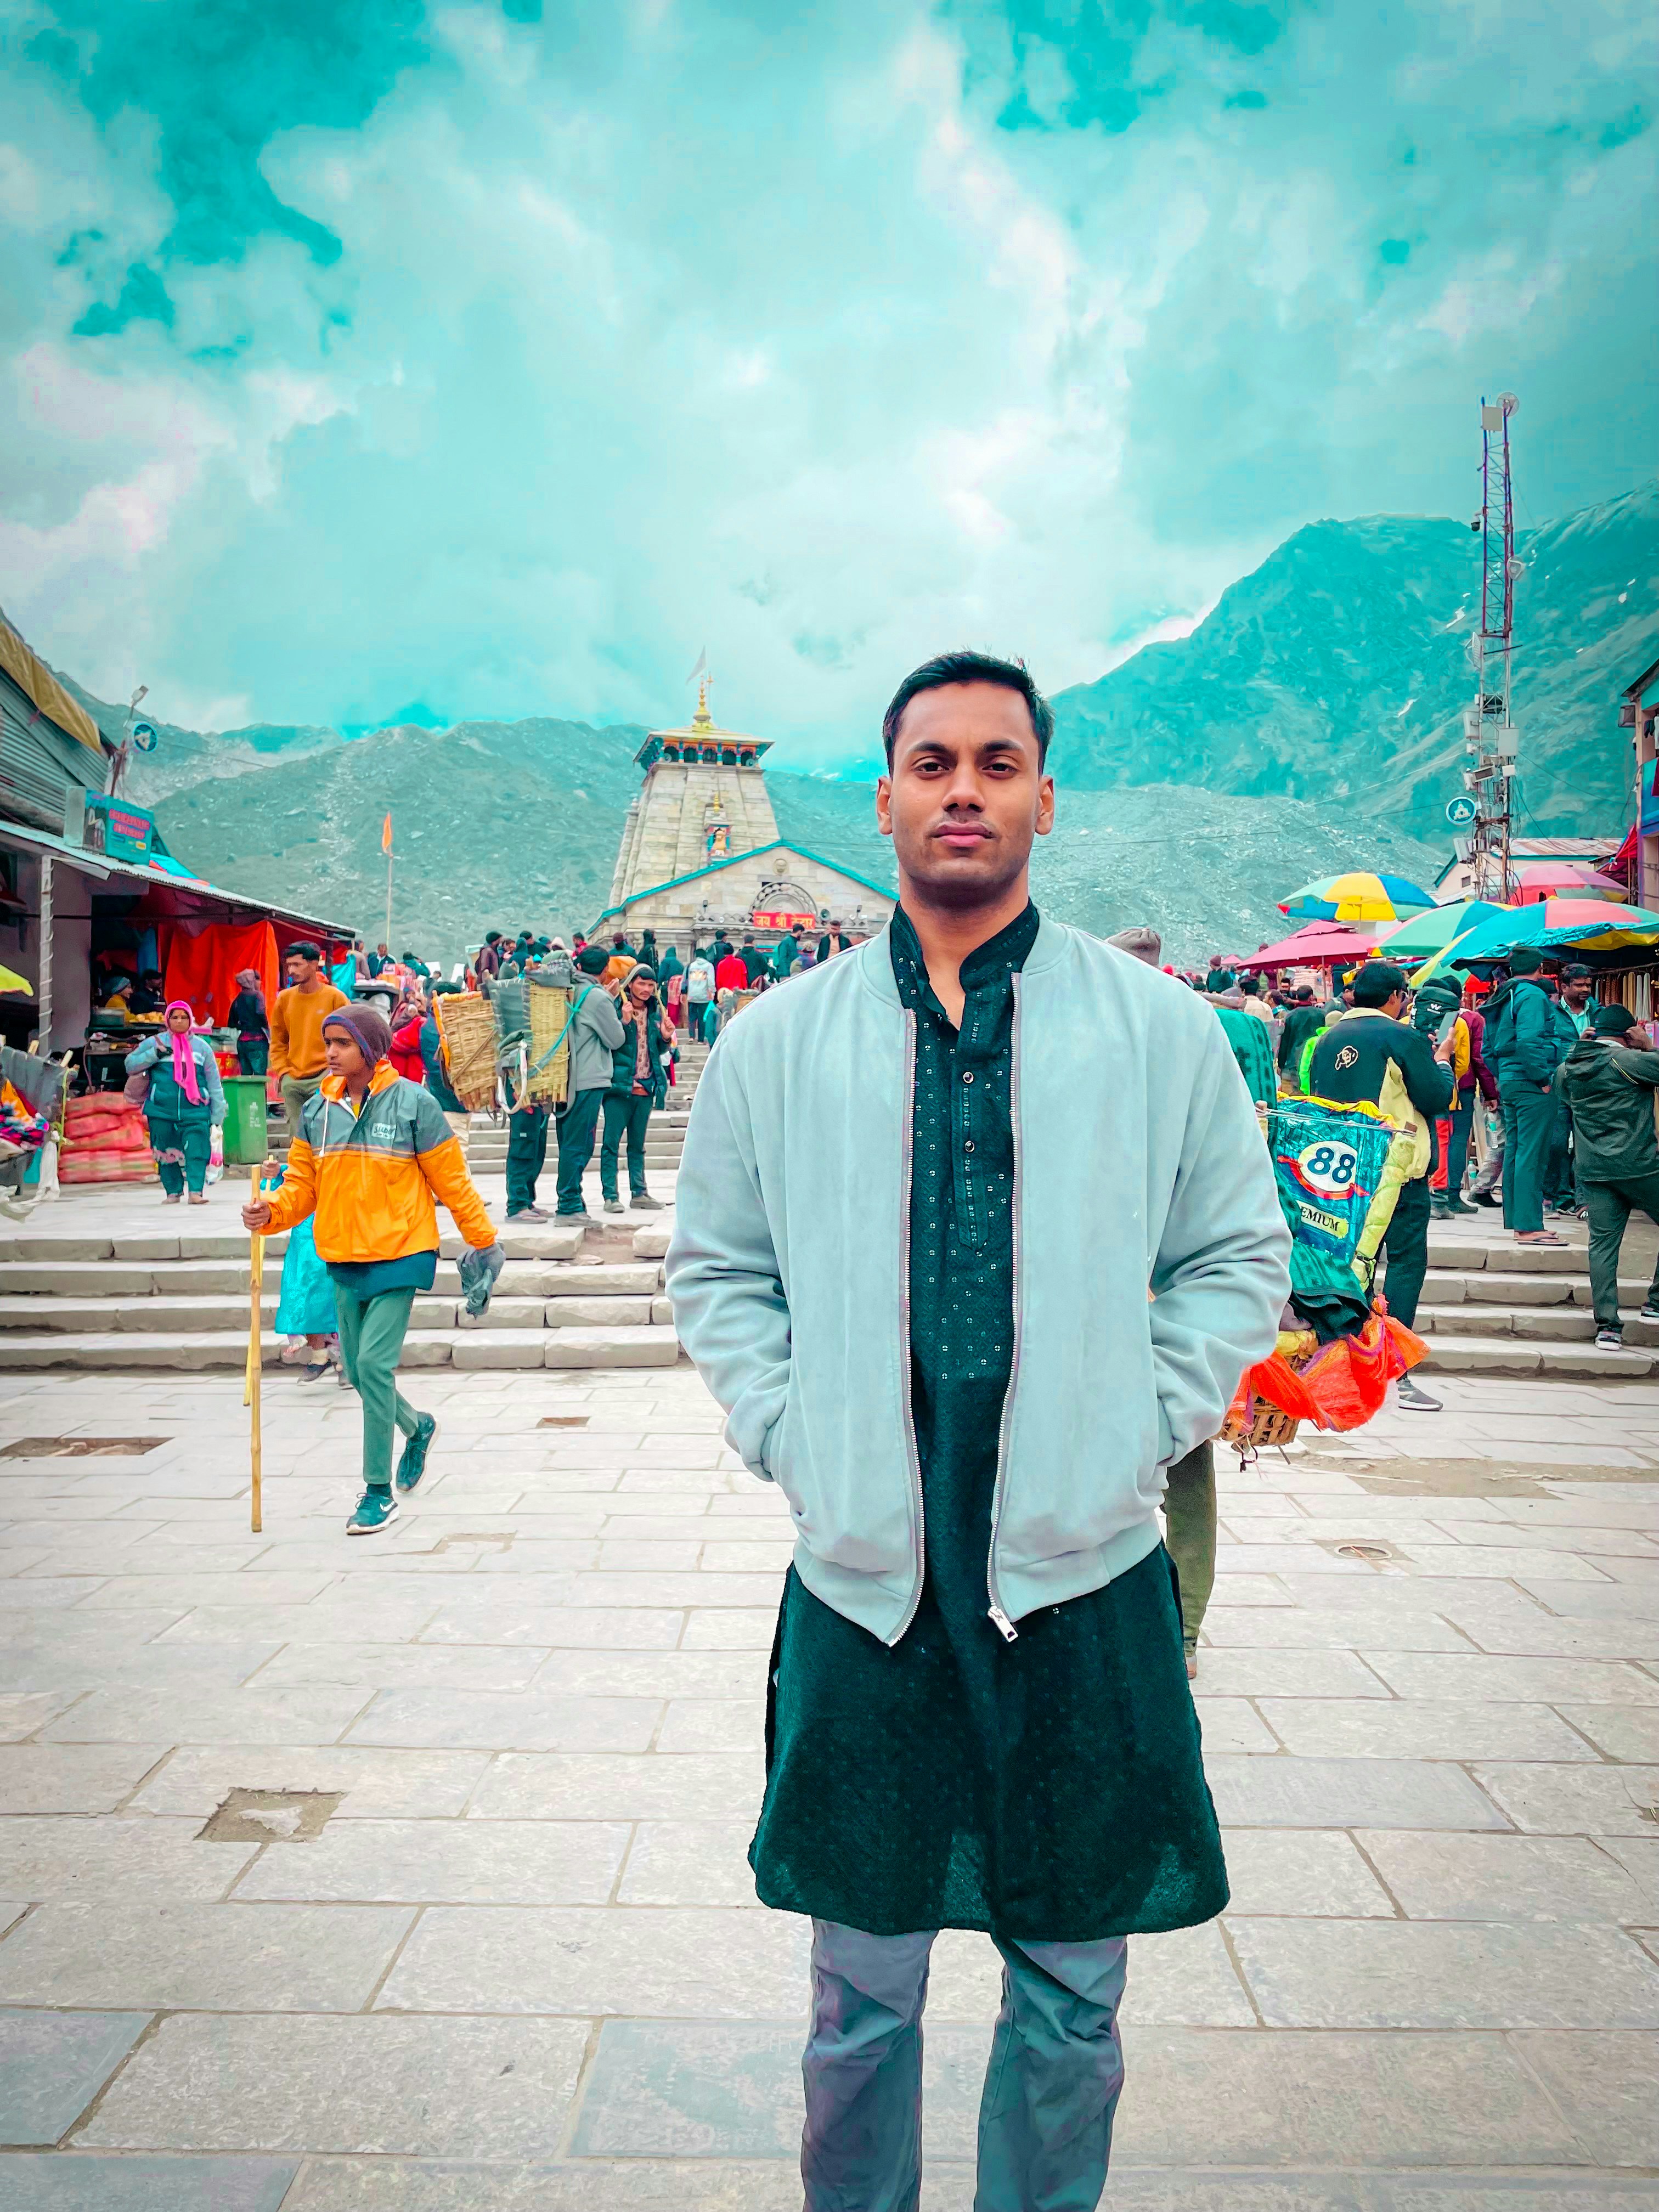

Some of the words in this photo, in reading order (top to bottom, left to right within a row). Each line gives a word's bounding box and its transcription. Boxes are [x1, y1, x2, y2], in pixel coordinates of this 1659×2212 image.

[756, 916, 770, 927] जय
[776, 913, 787, 928] श्री
[1307, 1147, 1356, 1184] 88
[1301, 1206, 1340, 1232] EMIUM
